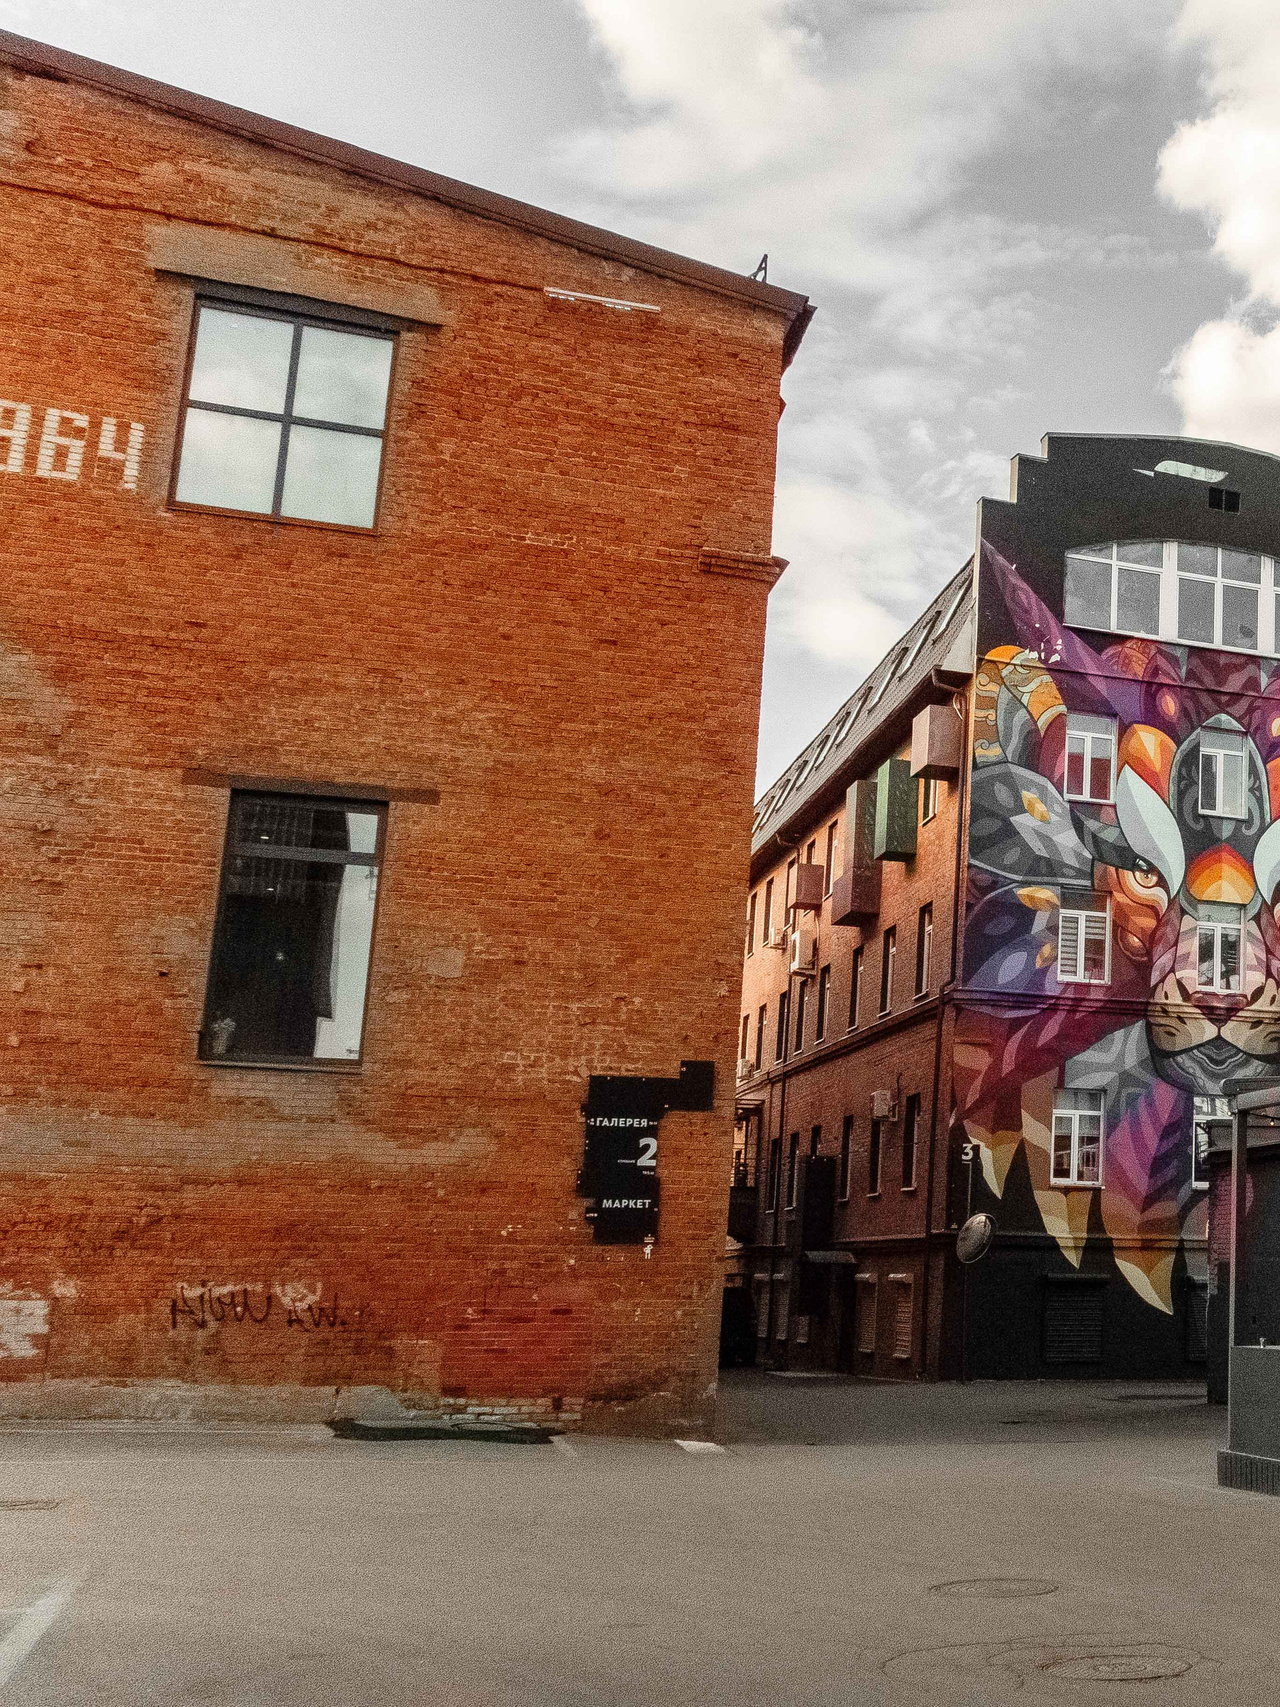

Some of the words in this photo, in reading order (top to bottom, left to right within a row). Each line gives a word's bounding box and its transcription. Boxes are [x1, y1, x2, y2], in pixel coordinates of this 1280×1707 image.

[0, 400, 145, 490] 964
[596, 1117, 648, 1128] ГАЛЕРЕЯ
[636, 1136, 658, 1167] 2
[961, 1143, 974, 1161] 3
[602, 1199, 652, 1209] МАРКЕТ
